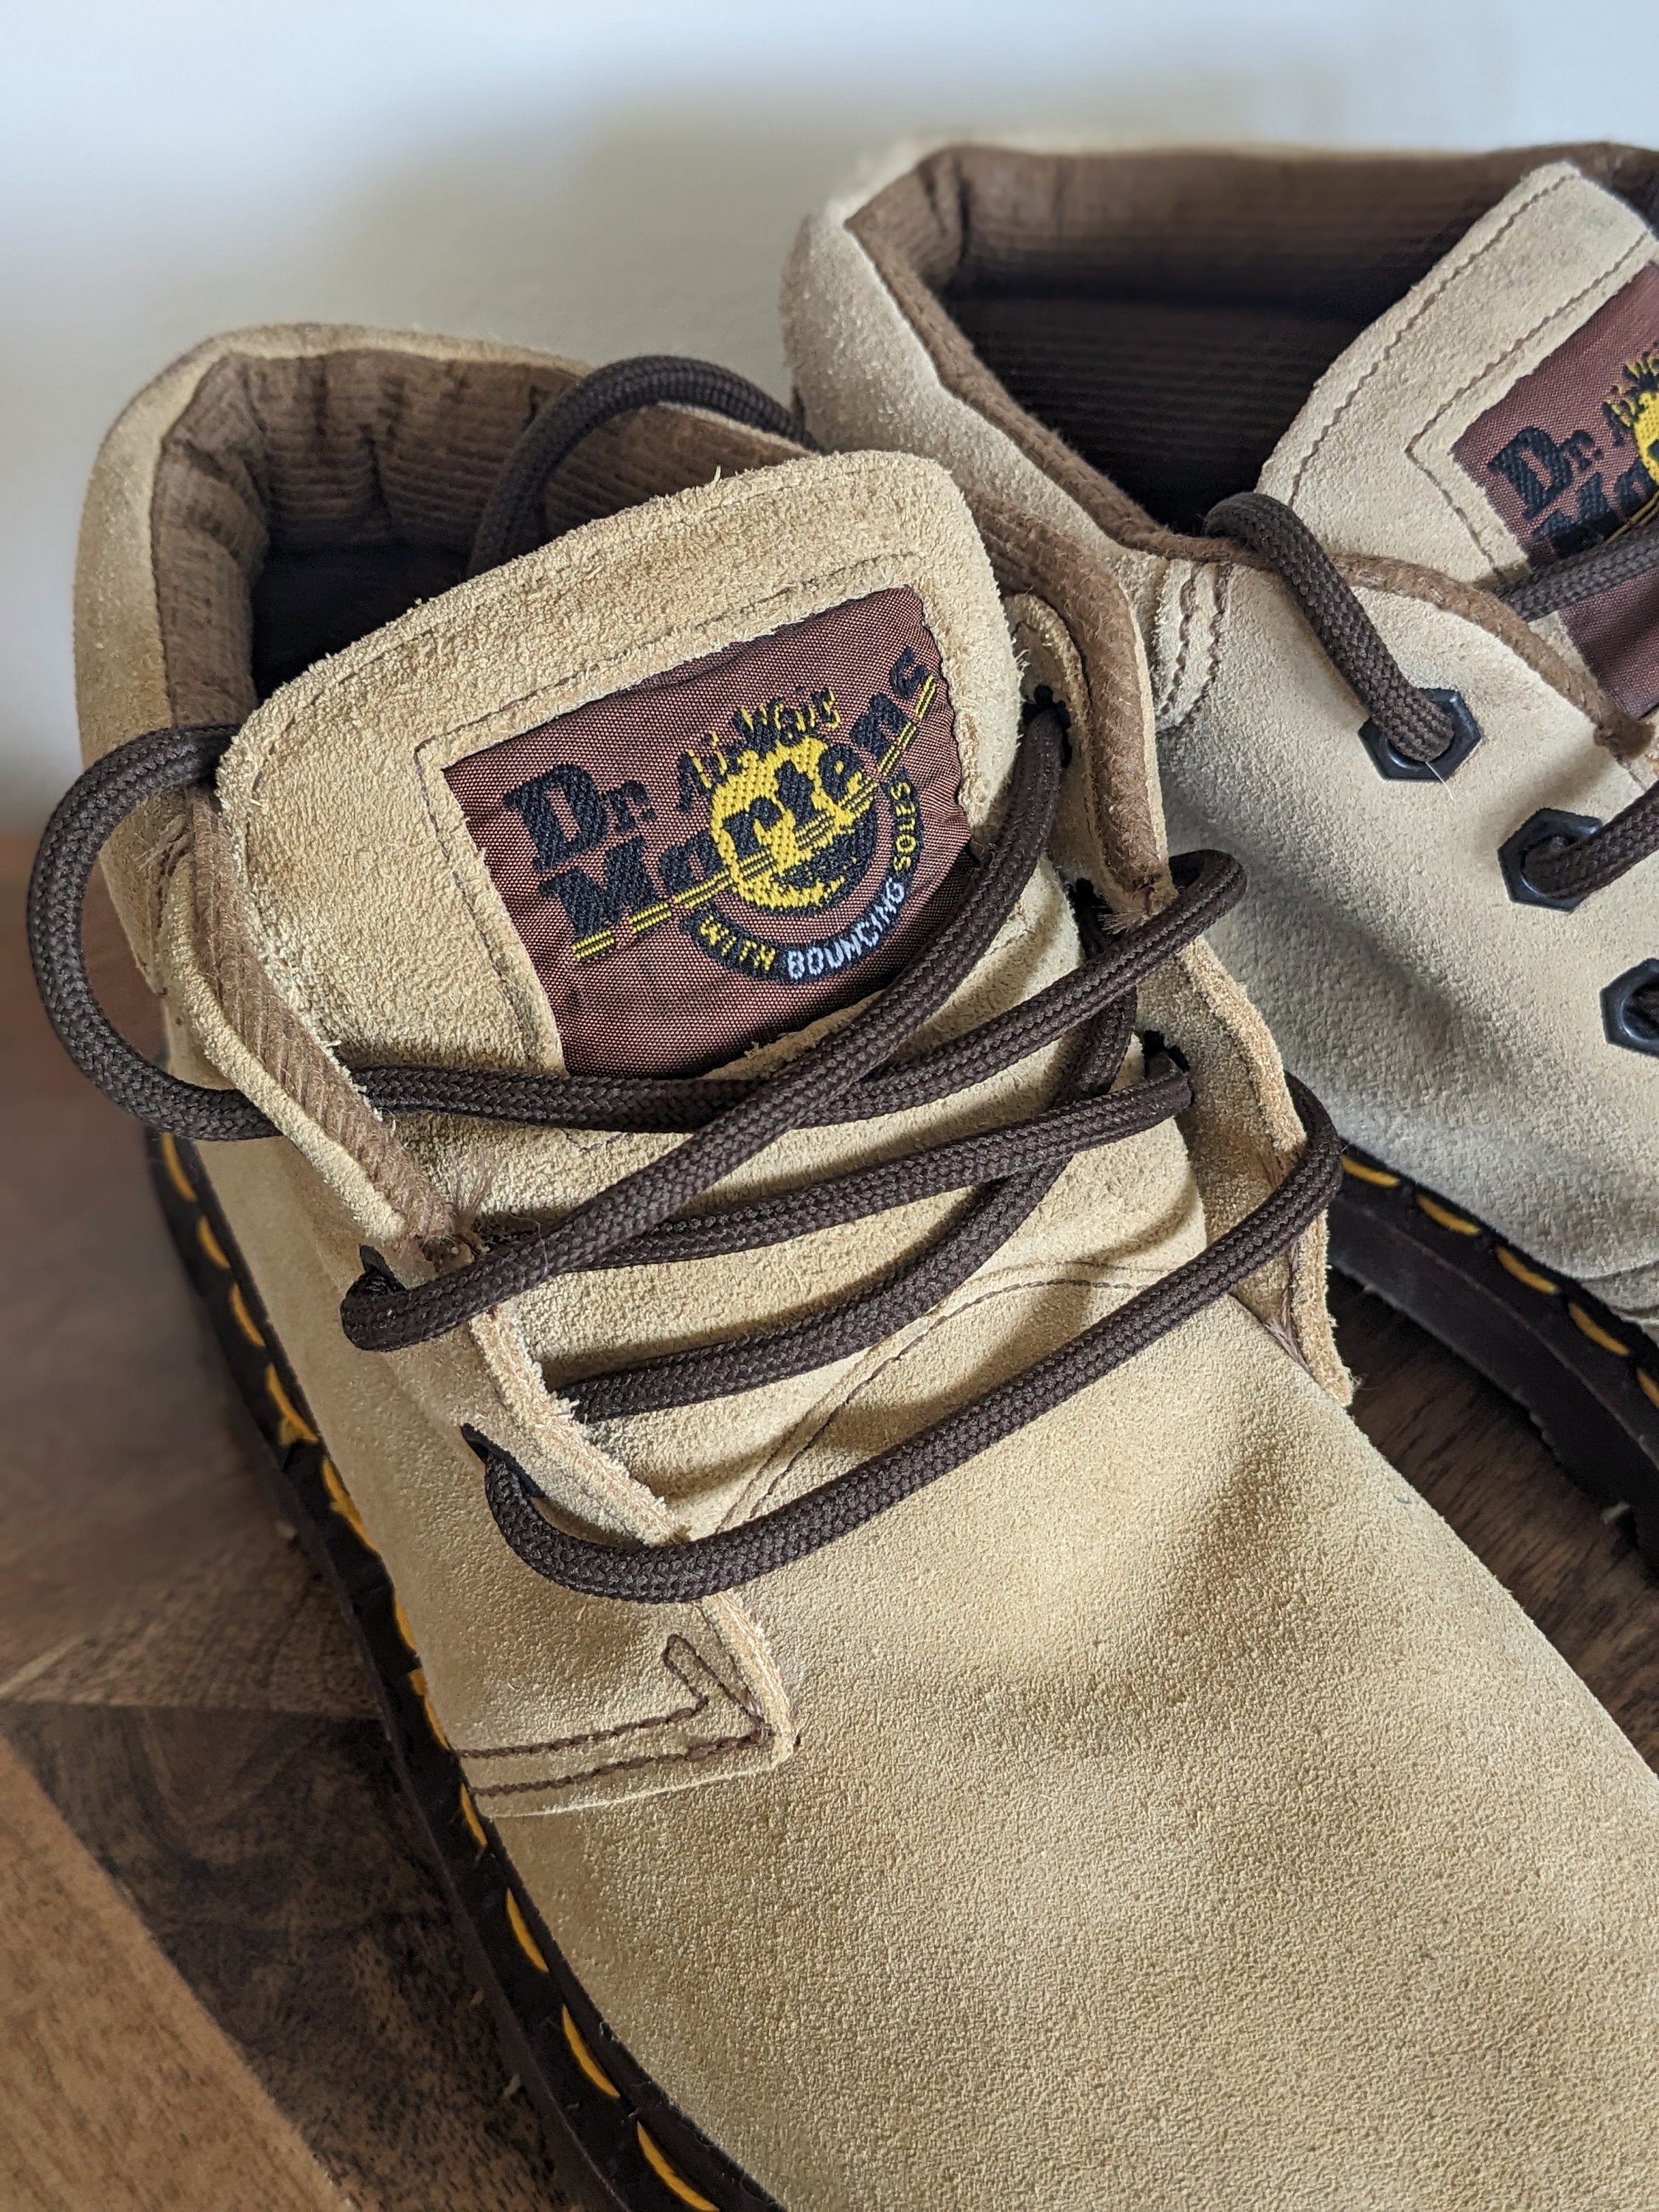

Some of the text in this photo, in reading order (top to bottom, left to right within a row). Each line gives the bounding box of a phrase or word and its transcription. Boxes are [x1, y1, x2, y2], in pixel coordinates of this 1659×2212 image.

[1488, 425, 1604, 521] Dr.
[503, 762, 657, 873] Dr.
[538, 646, 932, 945] Martens
[699, 782, 917, 980] WITH BOUNCING SOLES
